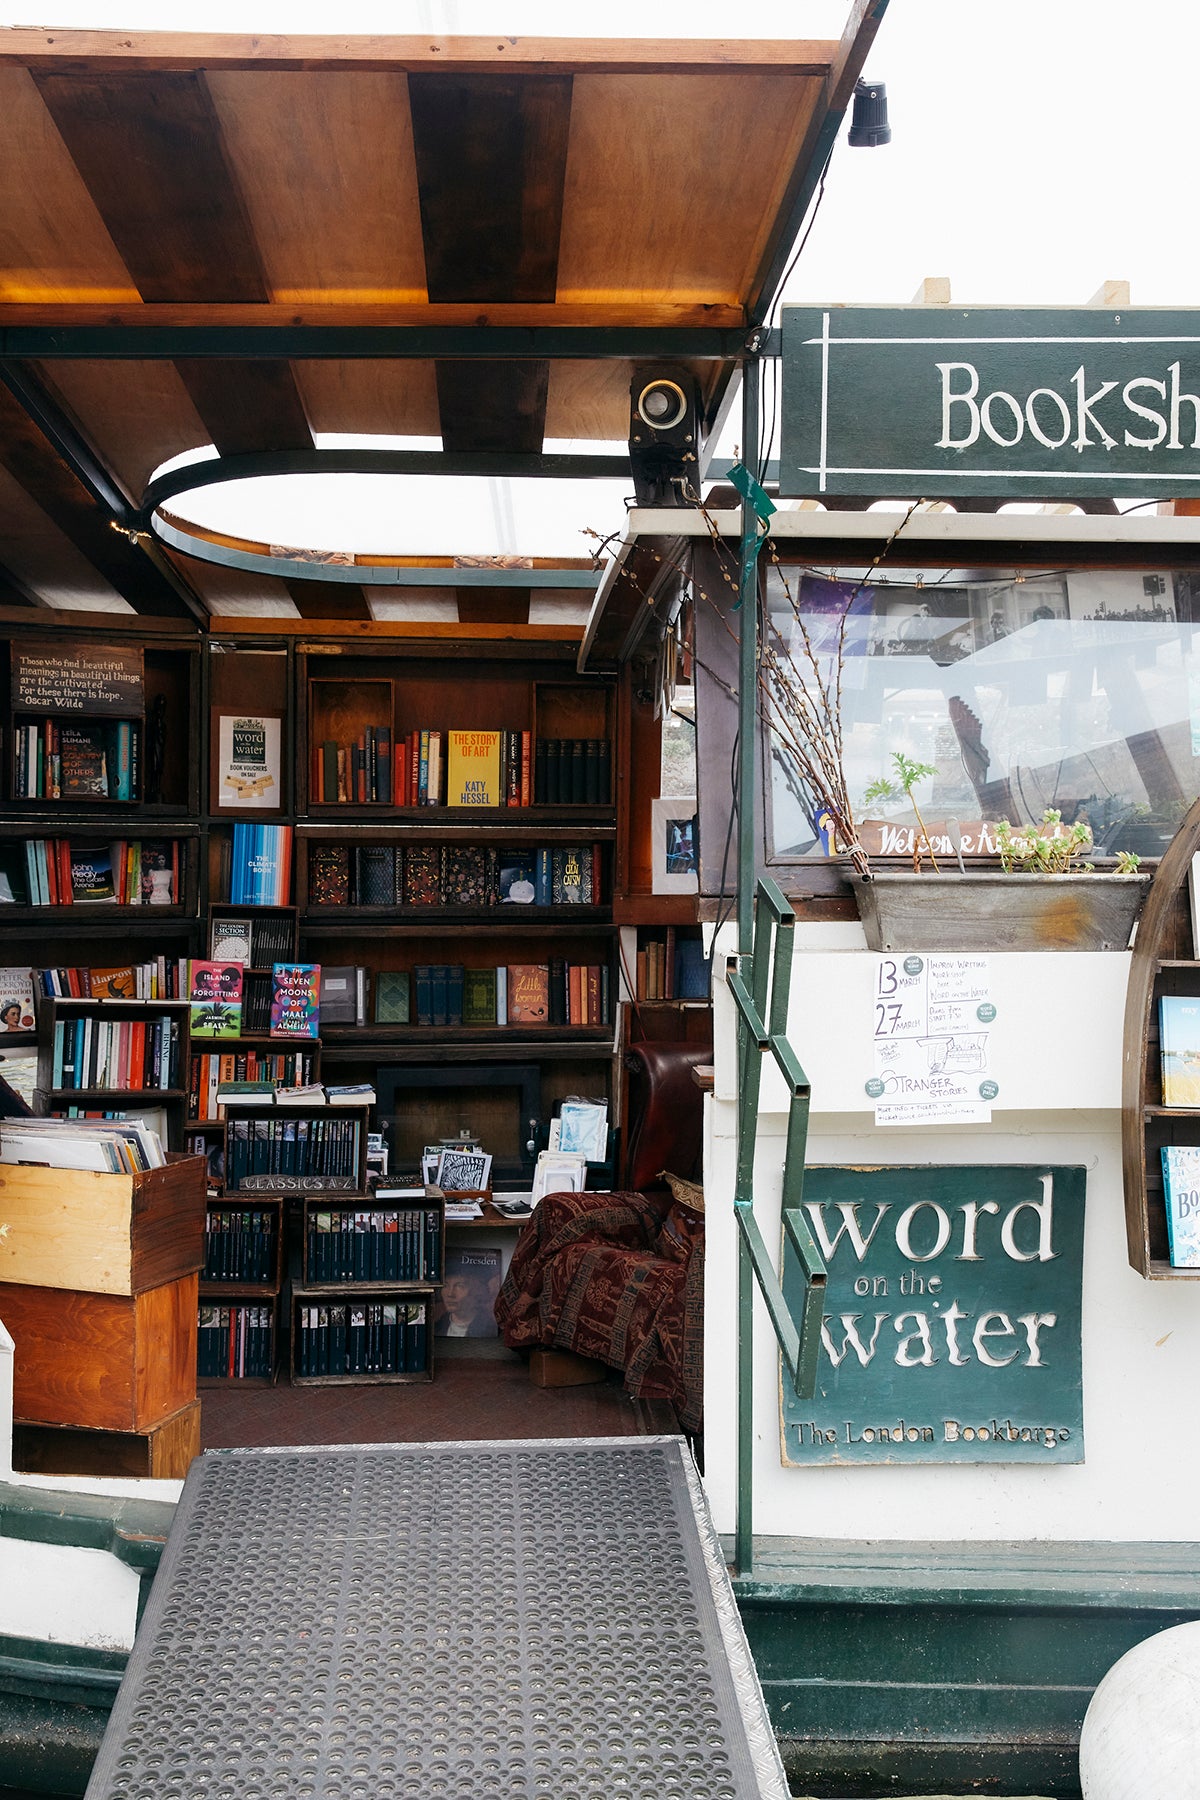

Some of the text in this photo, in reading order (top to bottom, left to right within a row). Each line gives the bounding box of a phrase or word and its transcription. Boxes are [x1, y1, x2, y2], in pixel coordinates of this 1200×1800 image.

[20, 656, 124, 671] Those who find beautiful
[20, 667, 140, 684] meanings in beautiful things
[38, 677, 52, 686] the
[54, 679, 106, 690] cultivated.
[20, 686, 124, 702] For these there is hope.
[55, 698, 83, 708] Wilde
[234, 732, 263, 742] word
[453, 734, 497, 745] THE STORY
[236, 746, 264, 754] water
[462, 746, 490, 757] OF ART
[466, 782, 486, 792] KATY
[461, 793, 490, 804] HESSEL
[91, 969, 132, 985] Harrow
[899, 977, 920, 987] MARCH
[516, 976, 542, 992] Little
[875, 1004, 902, 1035] 27
[896, 1020, 920, 1030] MARCH
[880, 1069, 954, 1094] STRANGER
[929, 1086, 968, 1099] STORIES
[245, 1177, 322, 1189] CLASSICS
[1176, 1190, 1200, 1219] BO
[804, 1172, 1063, 1262] word
[462, 1256, 496, 1265] Dresden
[853, 1268, 943, 1297] on the
[820, 1300, 1057, 1368] water
[791, 1420, 1072, 1448] The London Bookbarge
